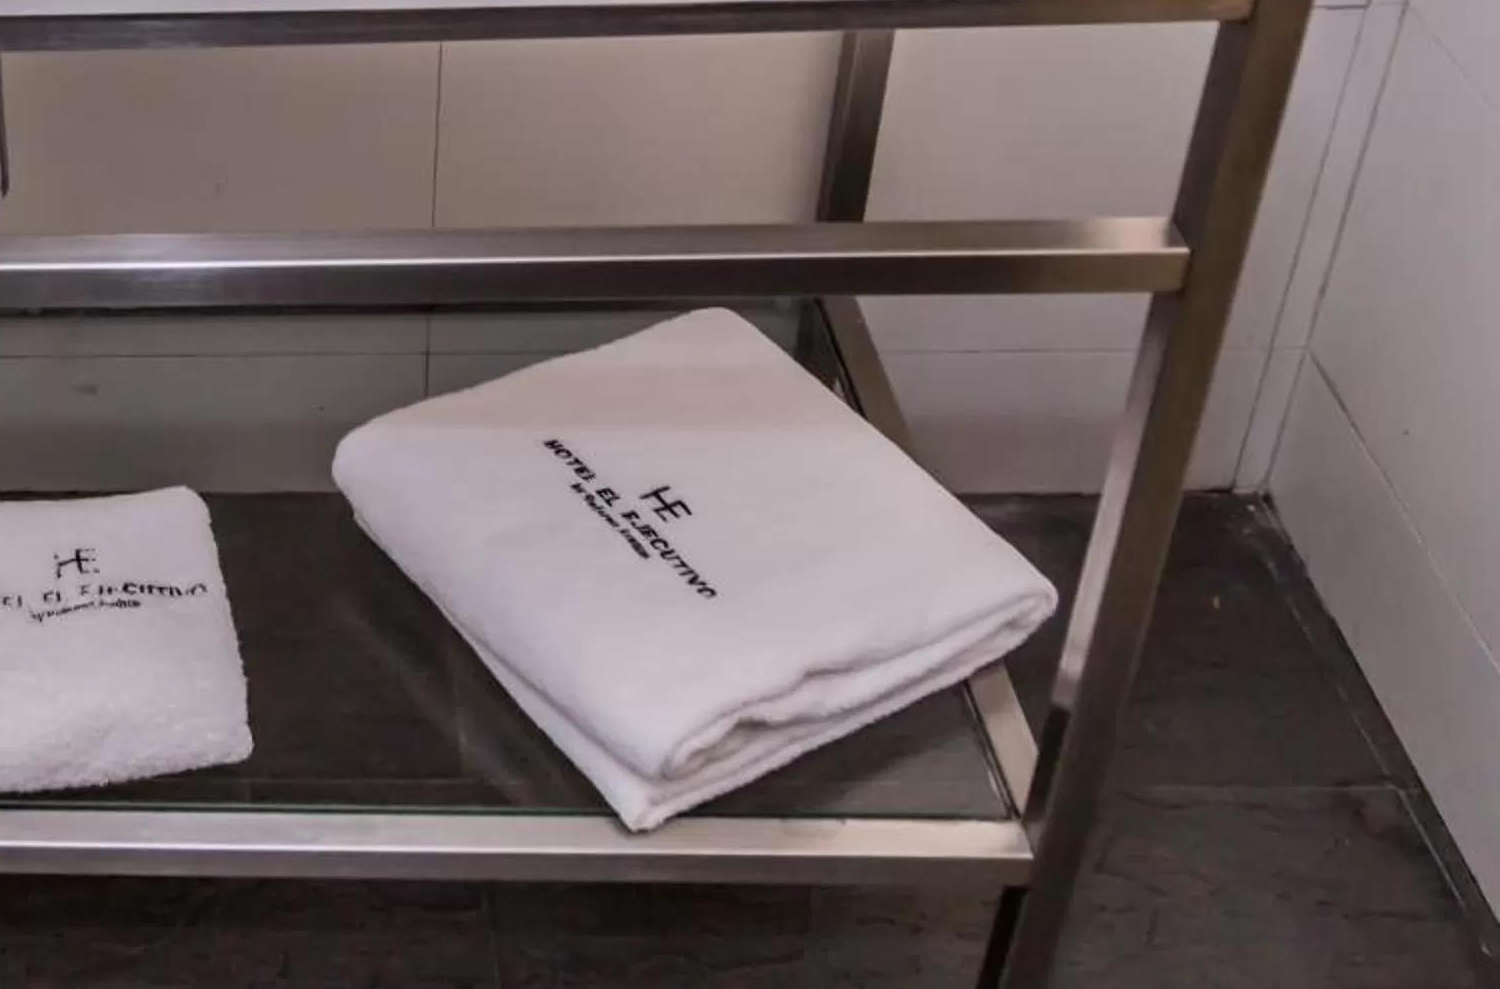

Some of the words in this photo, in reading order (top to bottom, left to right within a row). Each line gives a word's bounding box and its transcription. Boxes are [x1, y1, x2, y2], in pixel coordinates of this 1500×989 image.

[544, 439, 596, 482] HOTEL
[596, 487, 621, 507] EL
[621, 510, 717, 599] EJECUTIVO
